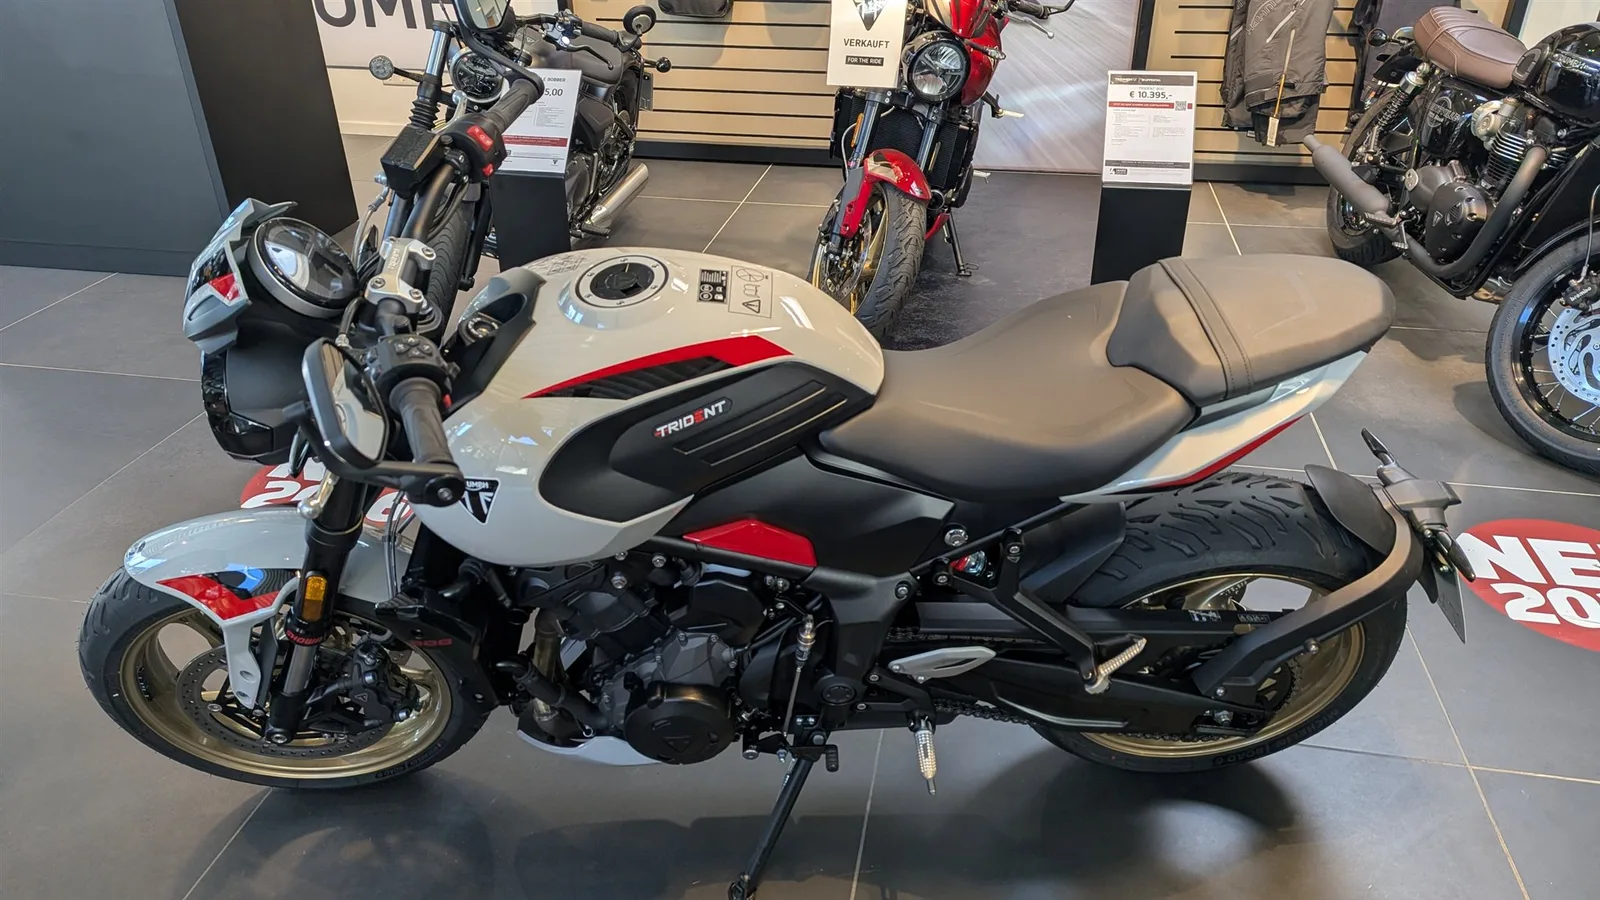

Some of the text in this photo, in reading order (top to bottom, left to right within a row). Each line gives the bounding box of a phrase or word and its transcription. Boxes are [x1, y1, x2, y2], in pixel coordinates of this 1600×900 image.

[843, 38, 890, 49] VERKAUFT
[1138, 91, 1173, 99] 10.395,-
[656, 400, 726, 437] TRIDENT
[465, 480, 489, 490] UMPH
[1456, 532, 1600, 590] NE
[1490, 582, 1600, 629] 20
